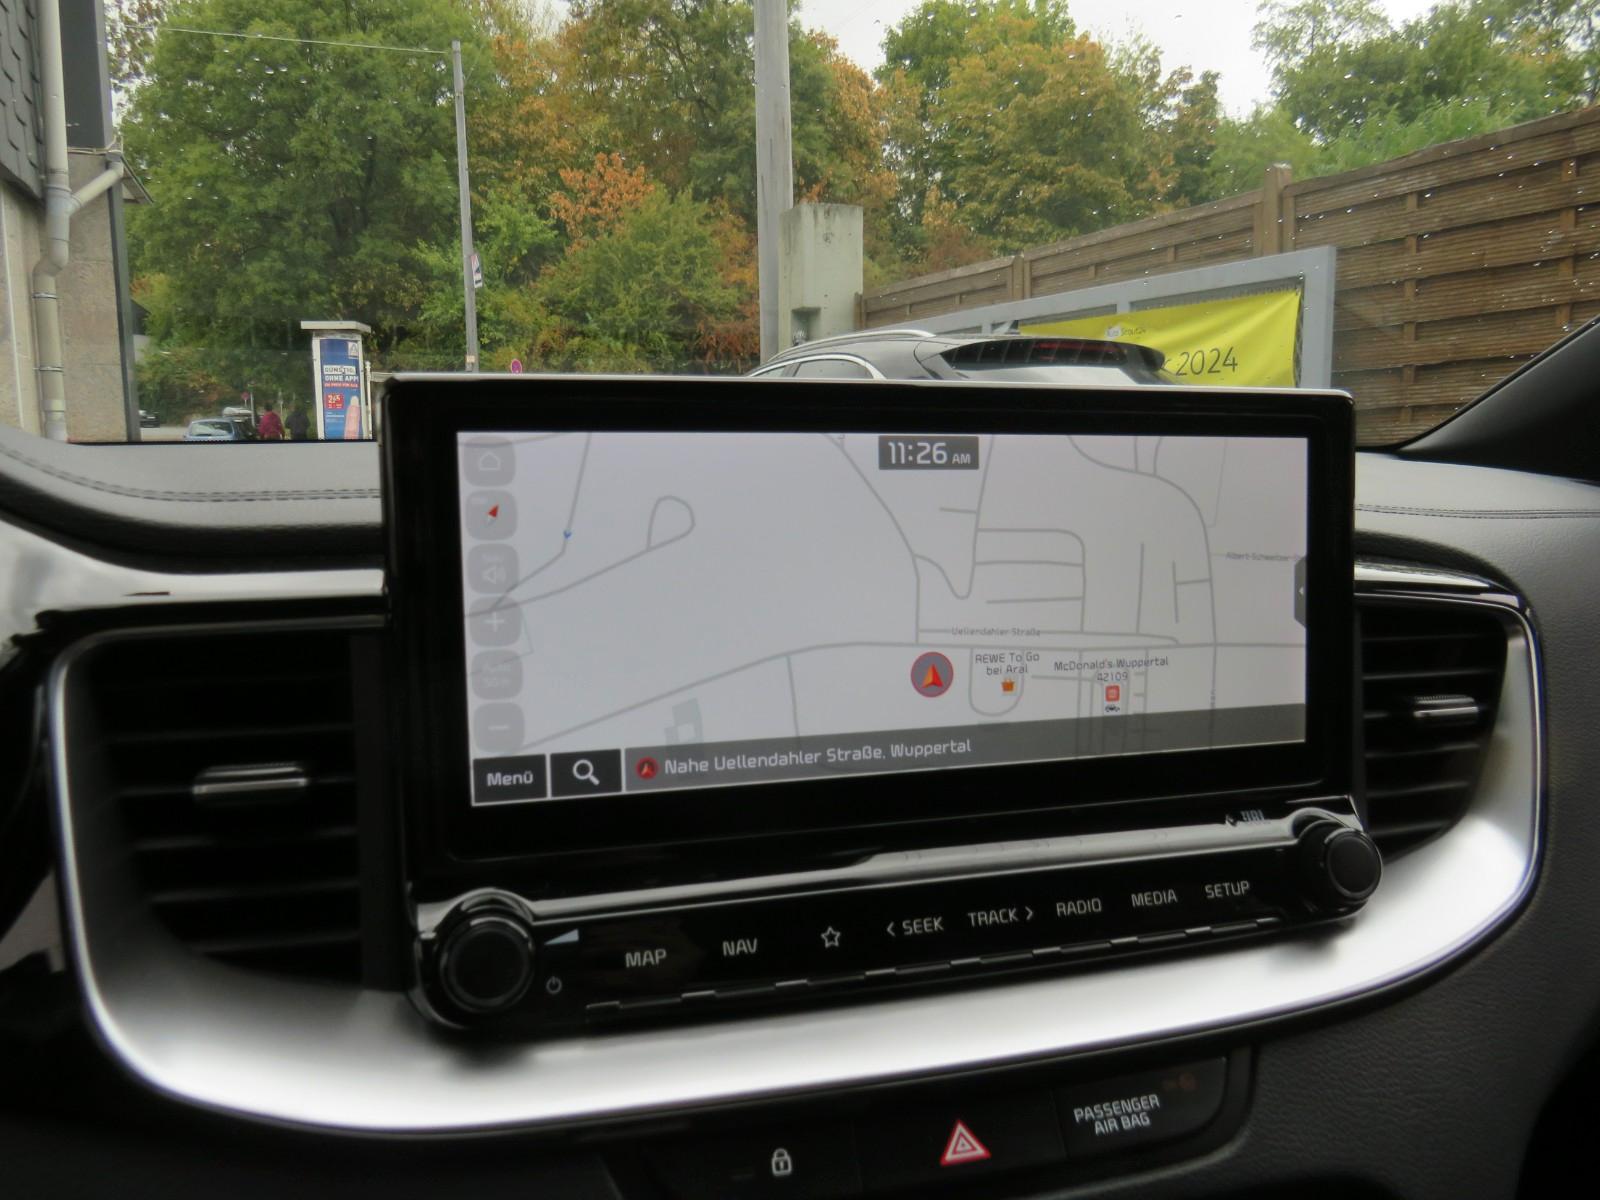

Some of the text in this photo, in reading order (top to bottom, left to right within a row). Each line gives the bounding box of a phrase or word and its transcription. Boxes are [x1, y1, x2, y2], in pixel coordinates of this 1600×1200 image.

[1175, 346, 1238, 376] 2024
[887, 441, 971, 464] 11:26 AM
[1011, 628, 1041, 637] Straße
[975, 651, 1040, 664] REWE To Go
[1053, 656, 1169, 672] McDonald's Wuppertal
[986, 664, 1028, 676] bei Aral
[1096, 671, 1129, 682] 42109
[664, 759, 710, 775] Nahe
[714, 751, 823, 771] Uellendahler
[890, 739, 972, 758] Wuppertal
[486, 771, 534, 787] Menü
[1131, 888, 1178, 908] MEDIA
[1204, 880, 1250, 900] SETUP
[967, 906, 1019, 928] TRACK
[1055, 898, 1103, 917] RADIO
[901, 916, 944, 936] SEEK
[722, 938, 759, 957] NAV
[624, 948, 668, 968] MAP
[1073, 1093, 1161, 1124] PASSENGER
[1094, 1111, 1151, 1136] AIR BAG
